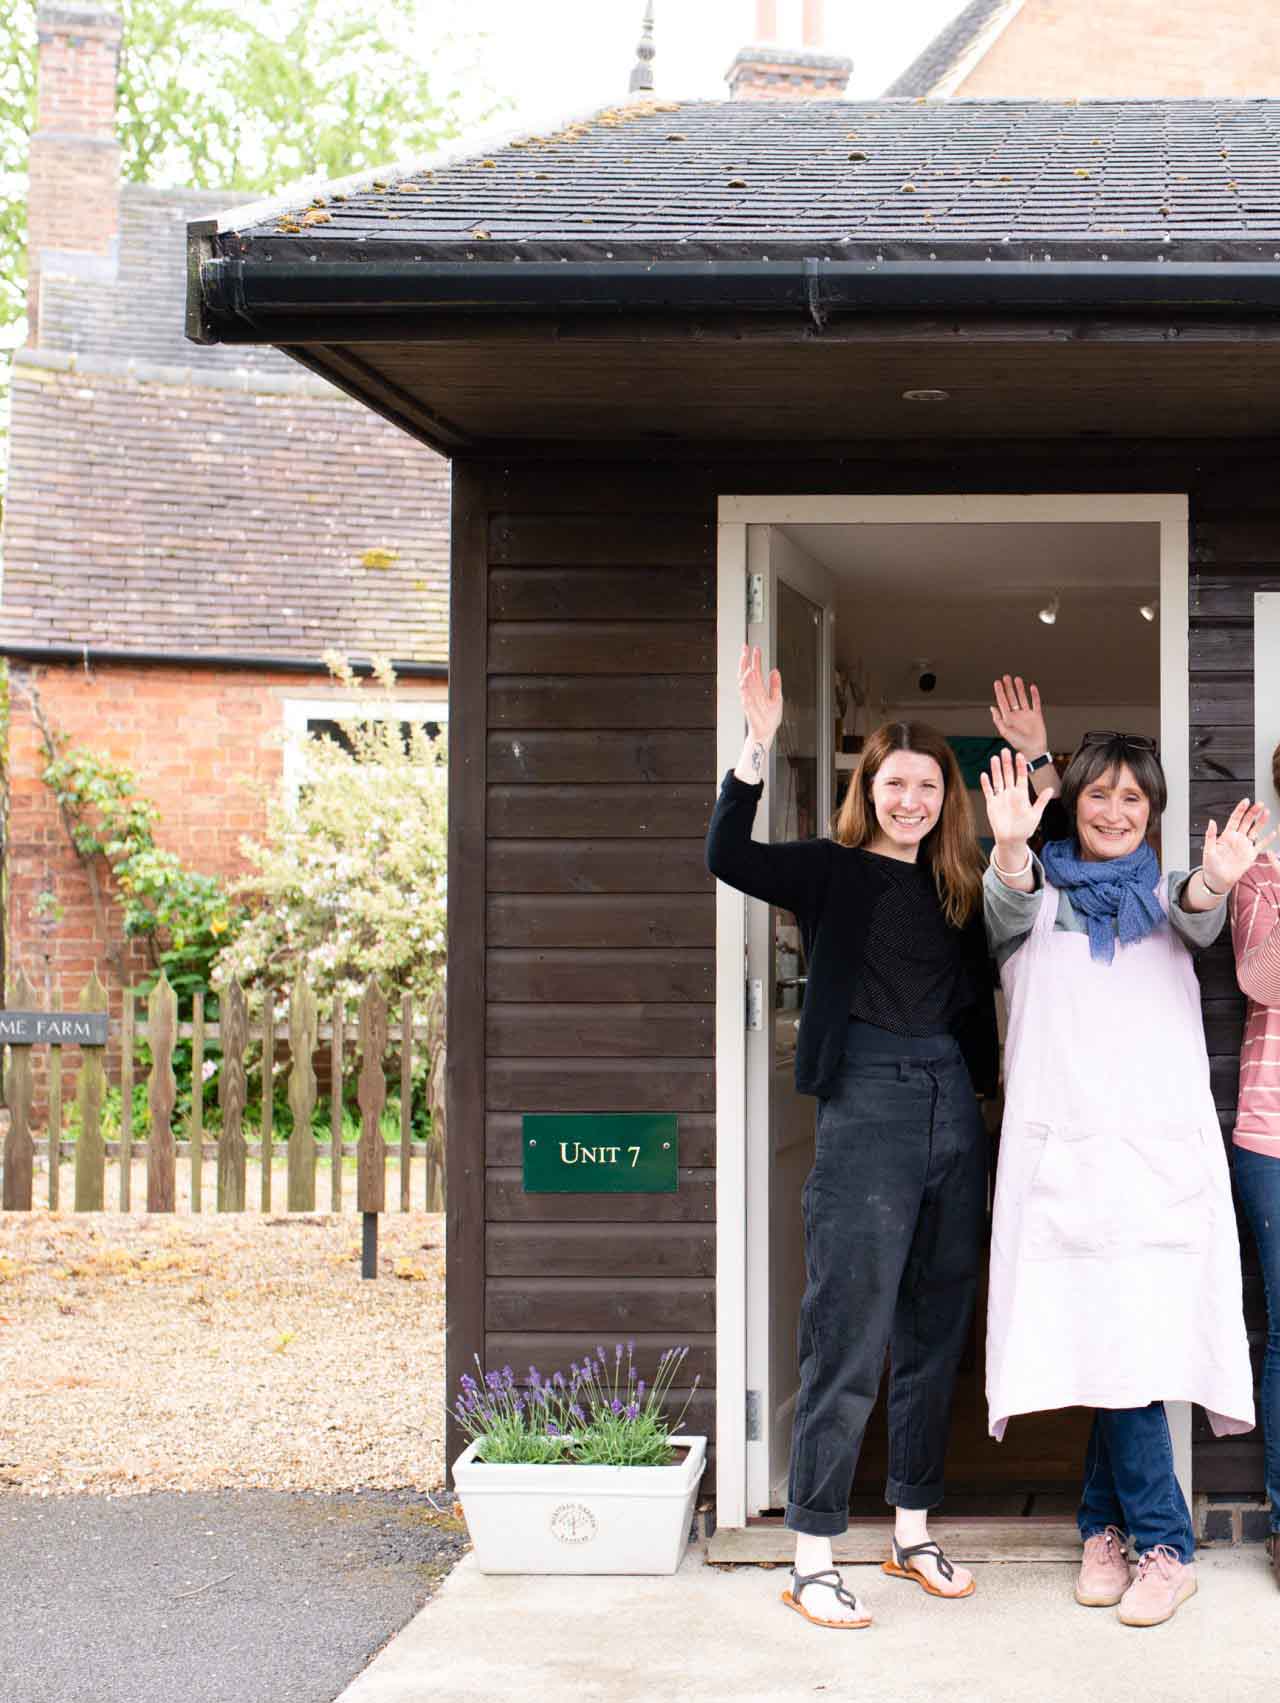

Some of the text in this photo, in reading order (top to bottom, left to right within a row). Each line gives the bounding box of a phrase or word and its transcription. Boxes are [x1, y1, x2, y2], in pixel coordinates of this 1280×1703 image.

[0, 1020, 91, 1037] ME FARM
[559, 1142, 641, 1168] UNIT 7
